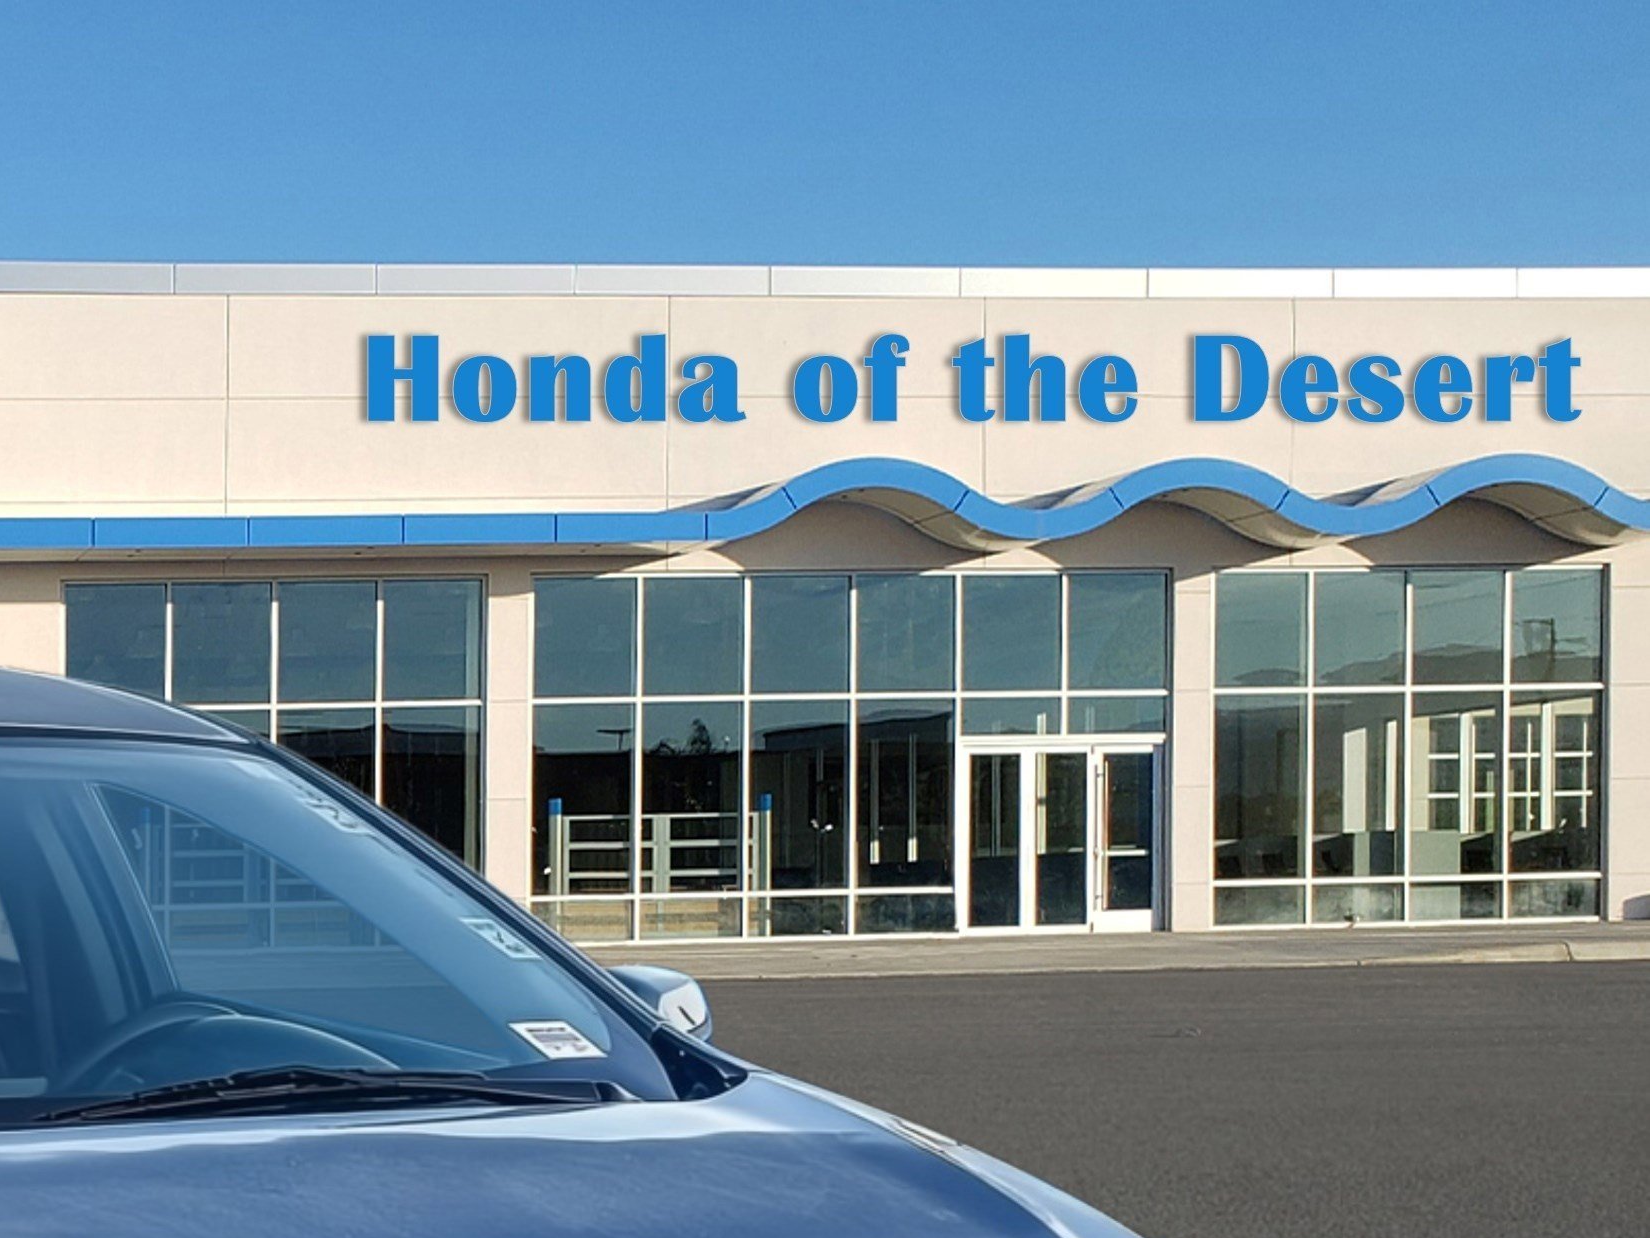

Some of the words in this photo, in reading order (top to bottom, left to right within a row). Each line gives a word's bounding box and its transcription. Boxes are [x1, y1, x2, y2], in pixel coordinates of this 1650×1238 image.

[367, 334, 746, 423] Honda
[794, 333, 910, 423] of
[952, 334, 1138, 423] the
[1194, 335, 1581, 423] Desert
